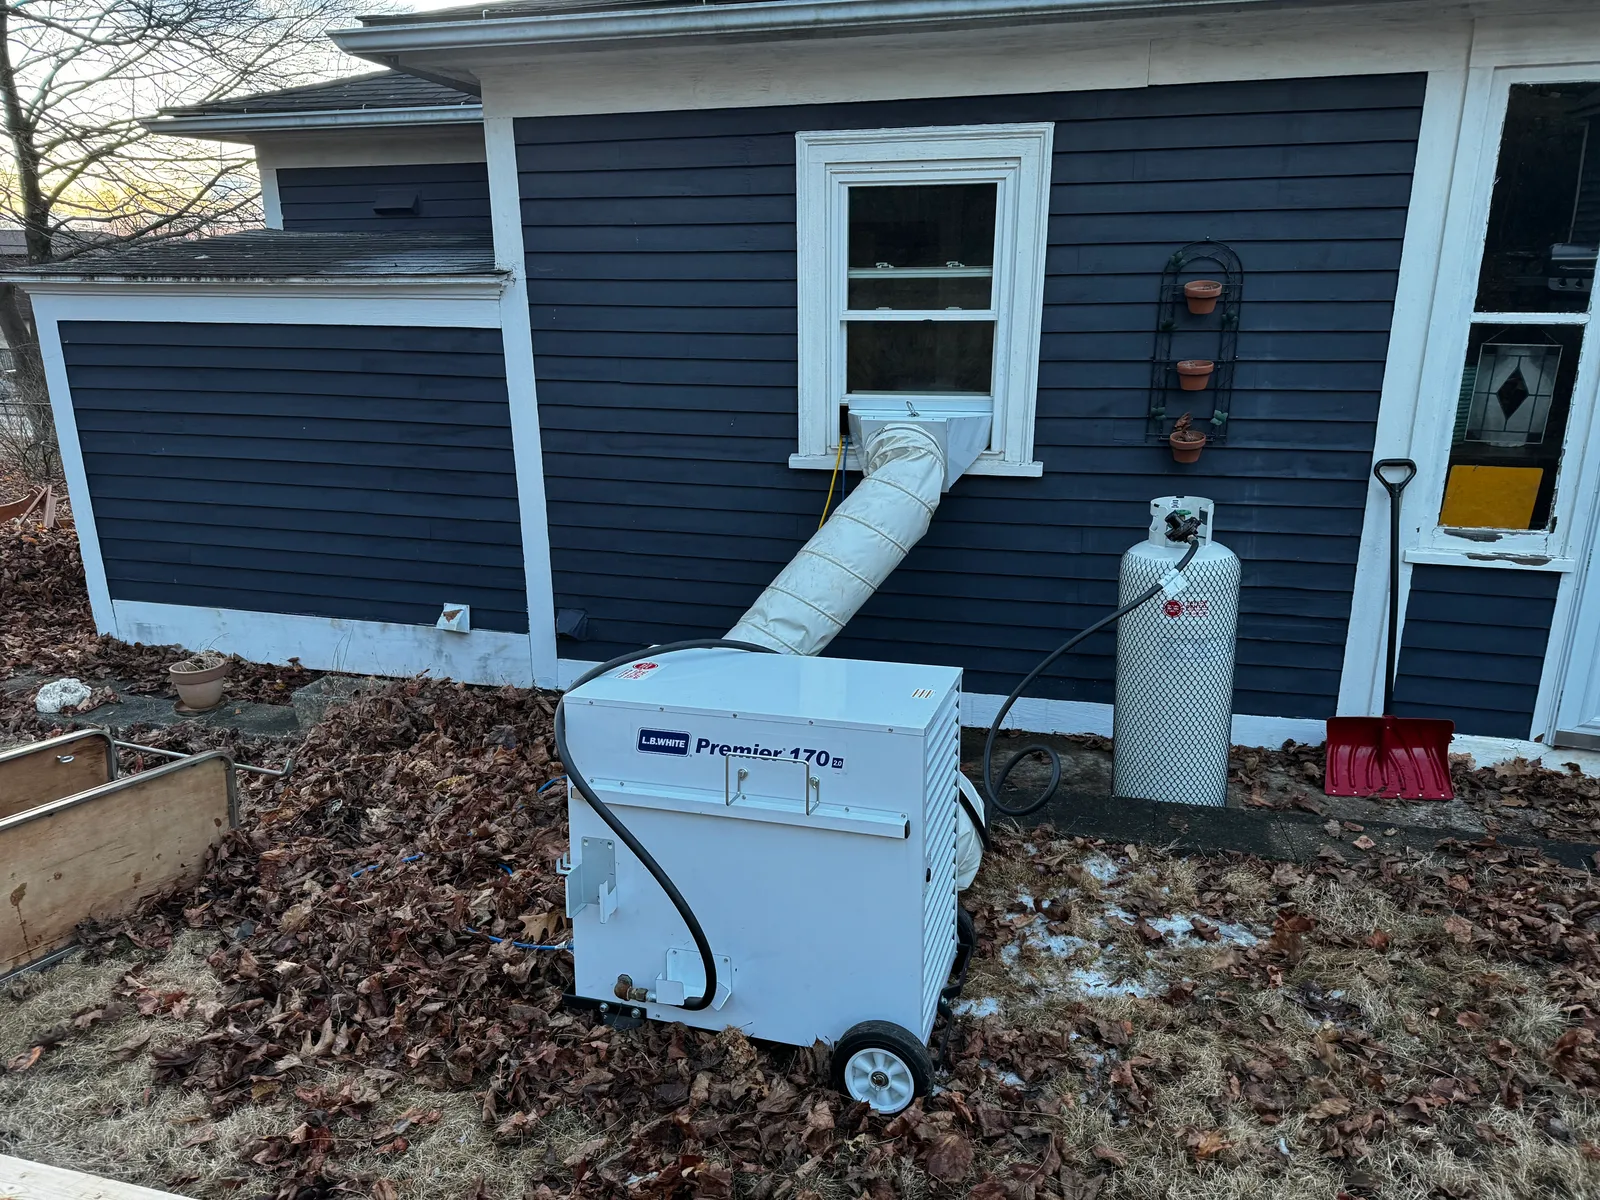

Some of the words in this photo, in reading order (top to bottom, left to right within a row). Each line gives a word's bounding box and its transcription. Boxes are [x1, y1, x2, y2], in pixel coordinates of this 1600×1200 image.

[641, 736, 686, 748] L.B.WHITE
[695, 737, 782, 762] Premier
[789, 747, 830, 767] 170
[832, 759, 843, 768] 2.0
